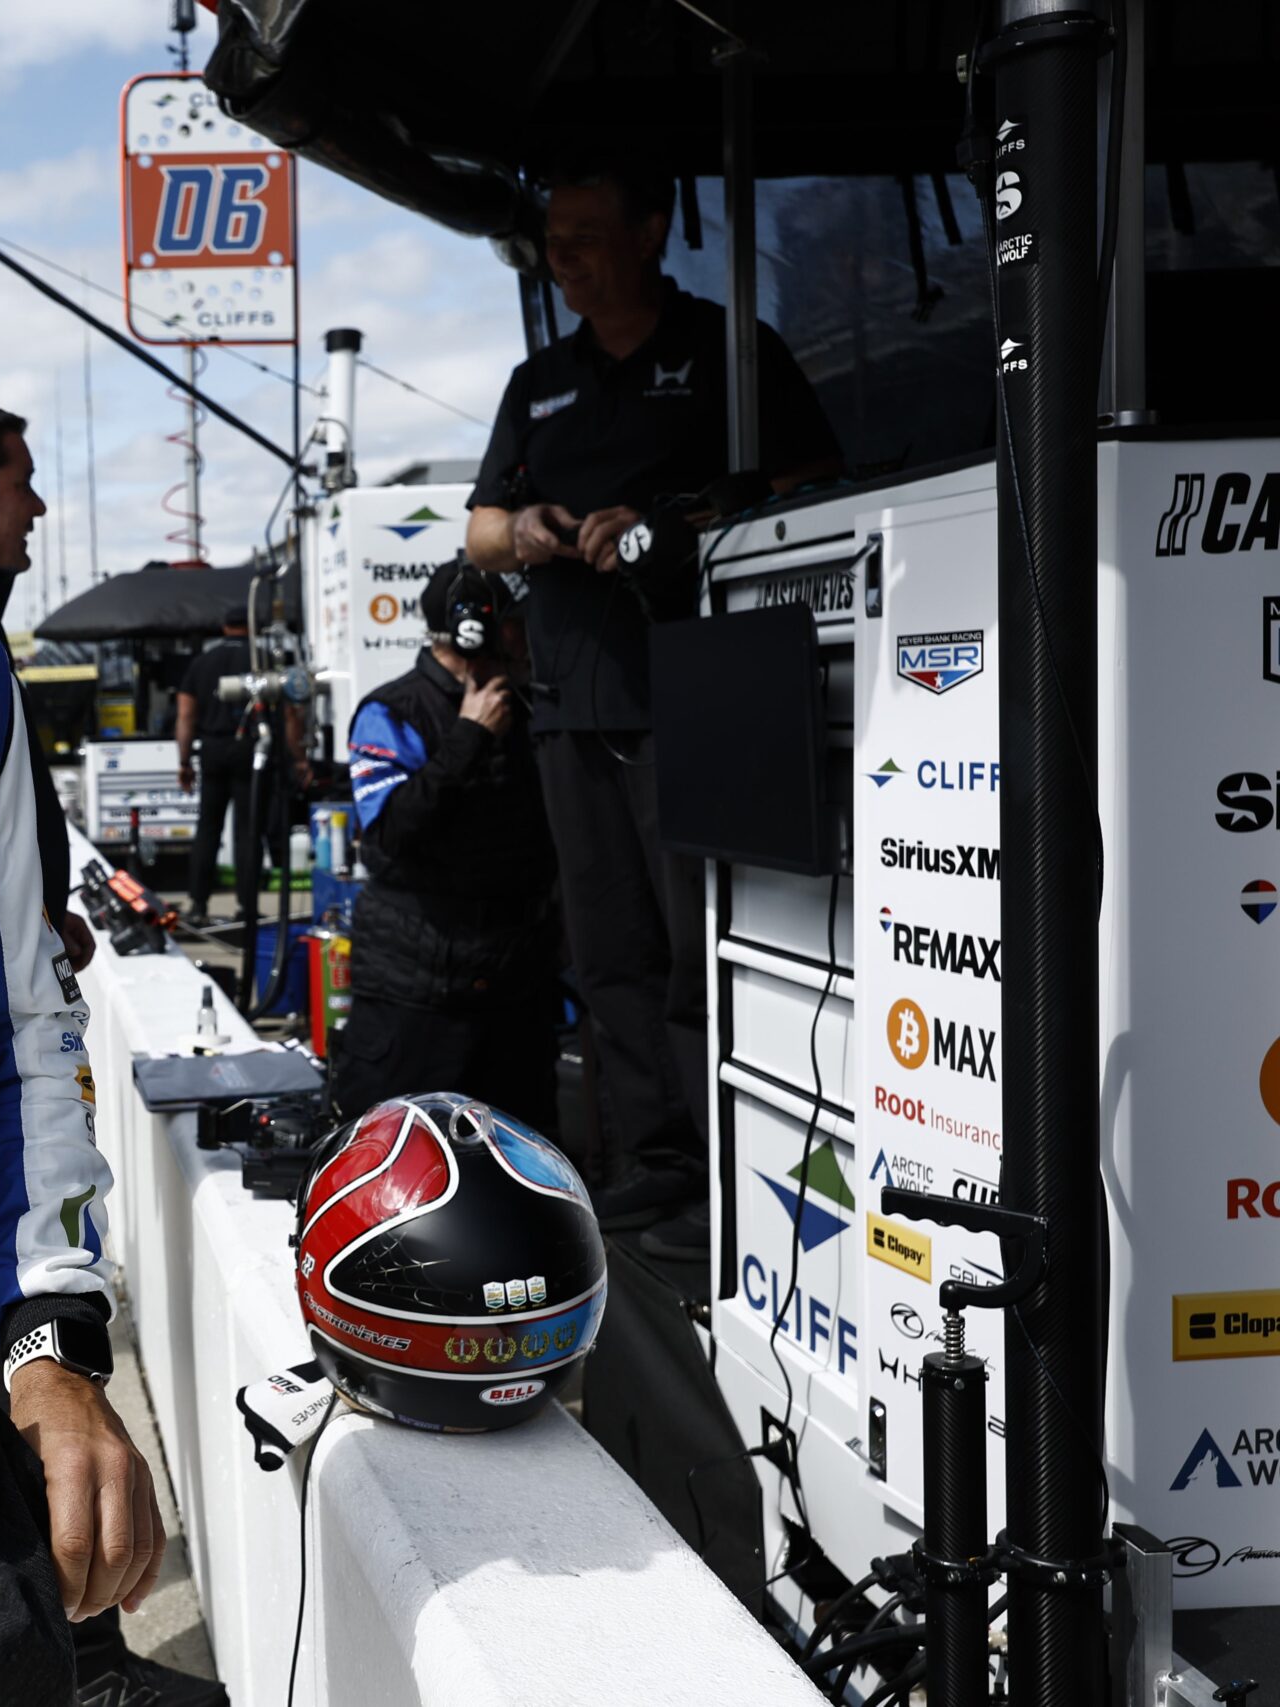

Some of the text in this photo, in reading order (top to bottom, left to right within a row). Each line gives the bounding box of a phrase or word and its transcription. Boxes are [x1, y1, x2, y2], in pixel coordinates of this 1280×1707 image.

[154, 164, 271, 256] 06
[999, 234, 1032, 252] ARCTIC
[1001, 246, 1028, 264] WOLF
[197, 311, 275, 327] CLIFFS
[898, 631, 982, 646] MEYER SHANK RACING
[901, 645, 979, 670] MSR
[918, 760, 1000, 792] CLIFF
[880, 838, 1000, 880] SiriusXM
[893, 921, 1001, 981] REMAX
[933, 1018, 996, 1082] MAX
[874, 1085, 1001, 1151] Root Insuranc
[892, 1154, 934, 1184] ARCTIC
[887, 1233, 923, 1266] Clopay
[742, 1255, 858, 1374] CLIFF
[490, 1385, 536, 1400] BELL
